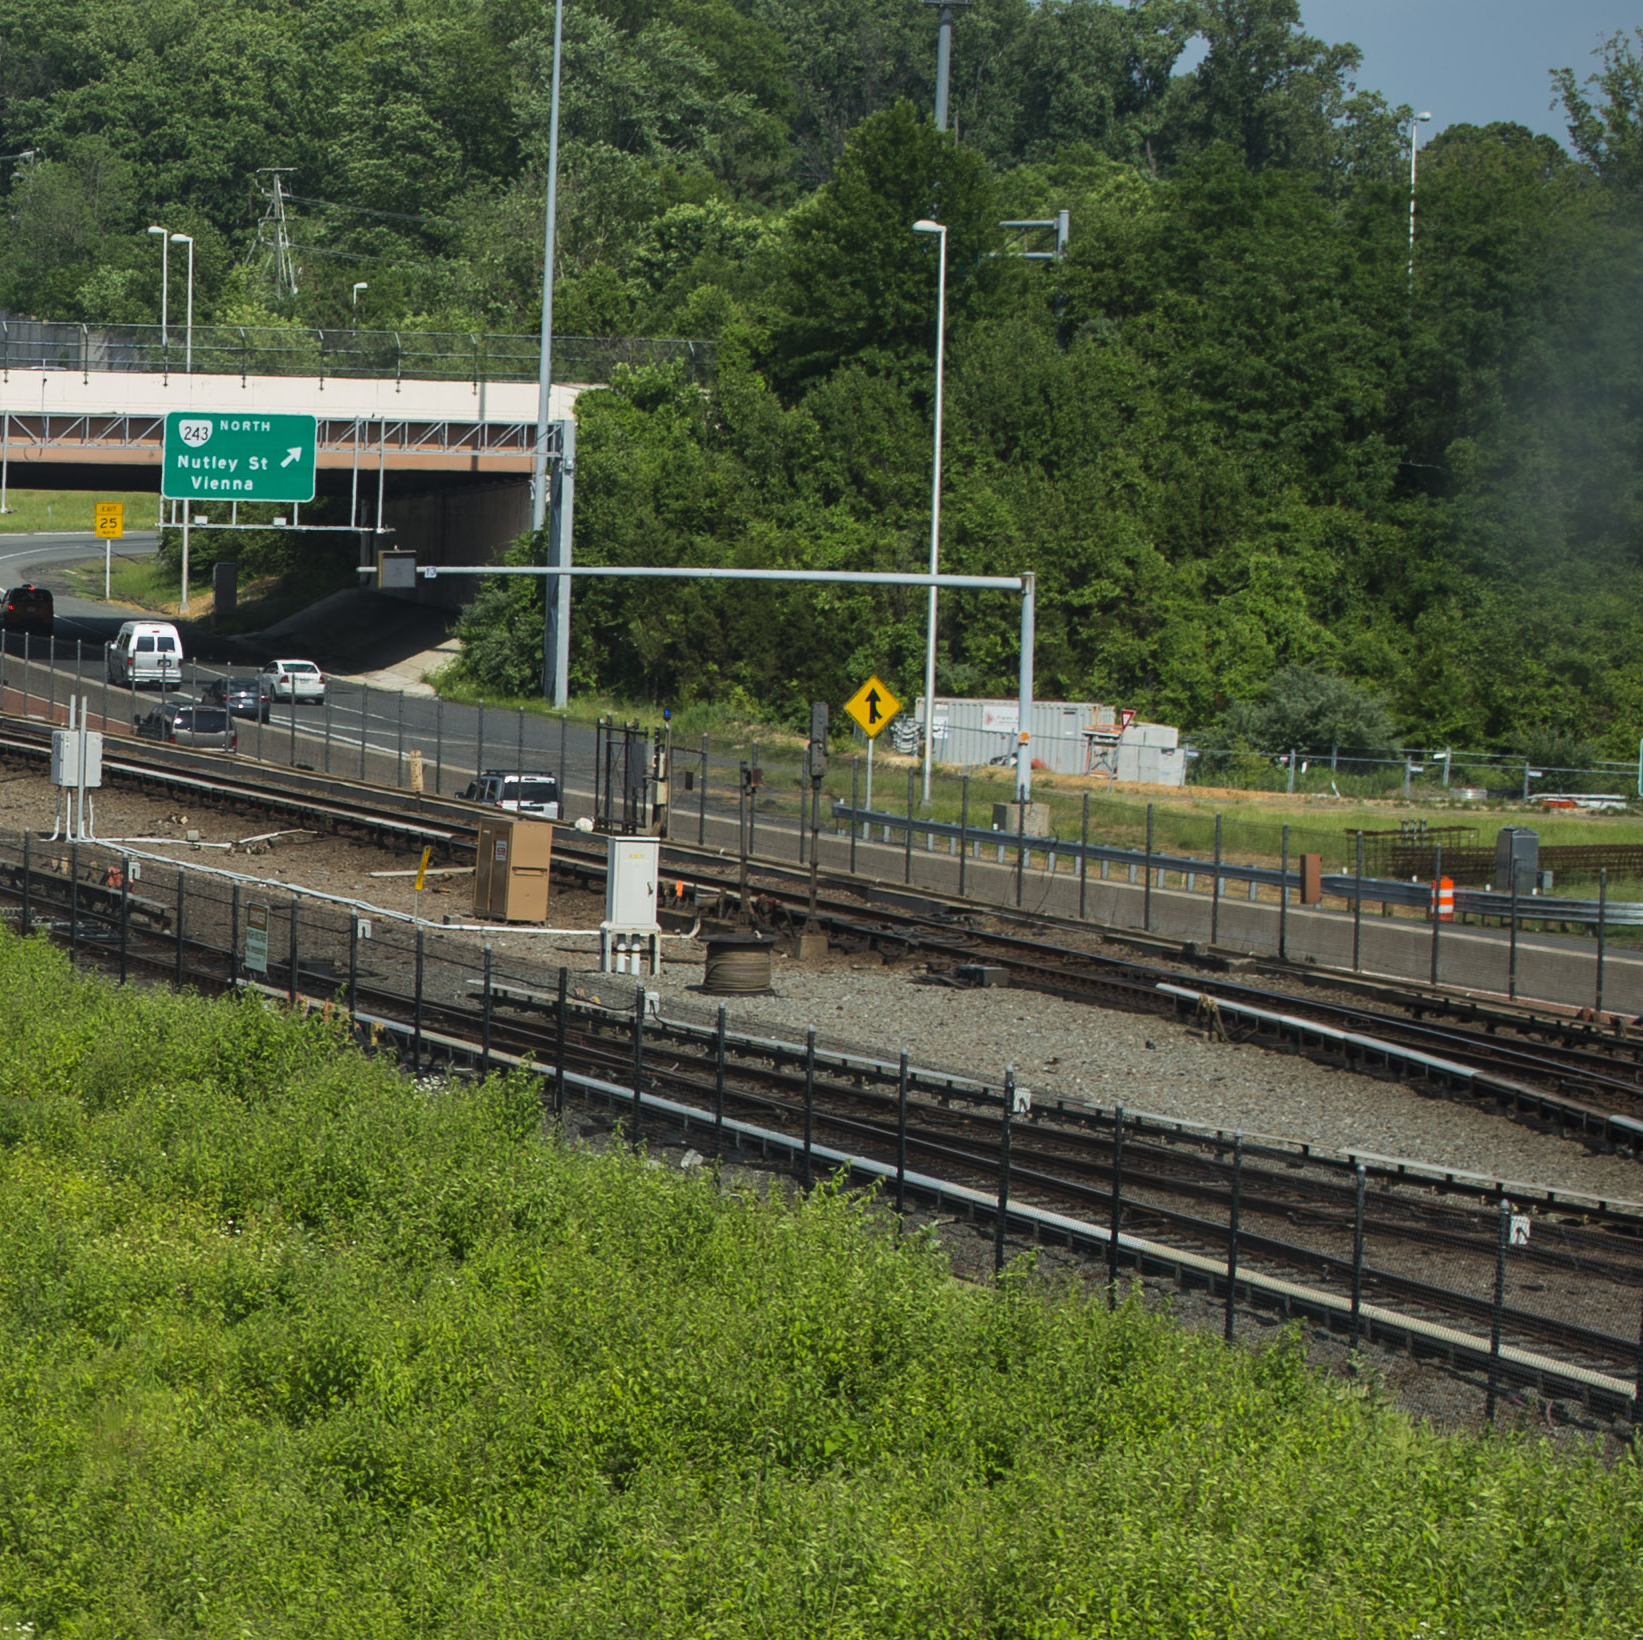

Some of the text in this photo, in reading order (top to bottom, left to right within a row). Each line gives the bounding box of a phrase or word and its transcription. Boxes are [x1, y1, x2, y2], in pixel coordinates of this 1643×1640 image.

[184, 426, 209, 441] 243
[219, 420, 271, 432] NORTH
[177, 454, 268, 472] Nutley St
[190, 476, 254, 491] Vienna
[99, 517, 118, 529] 25
